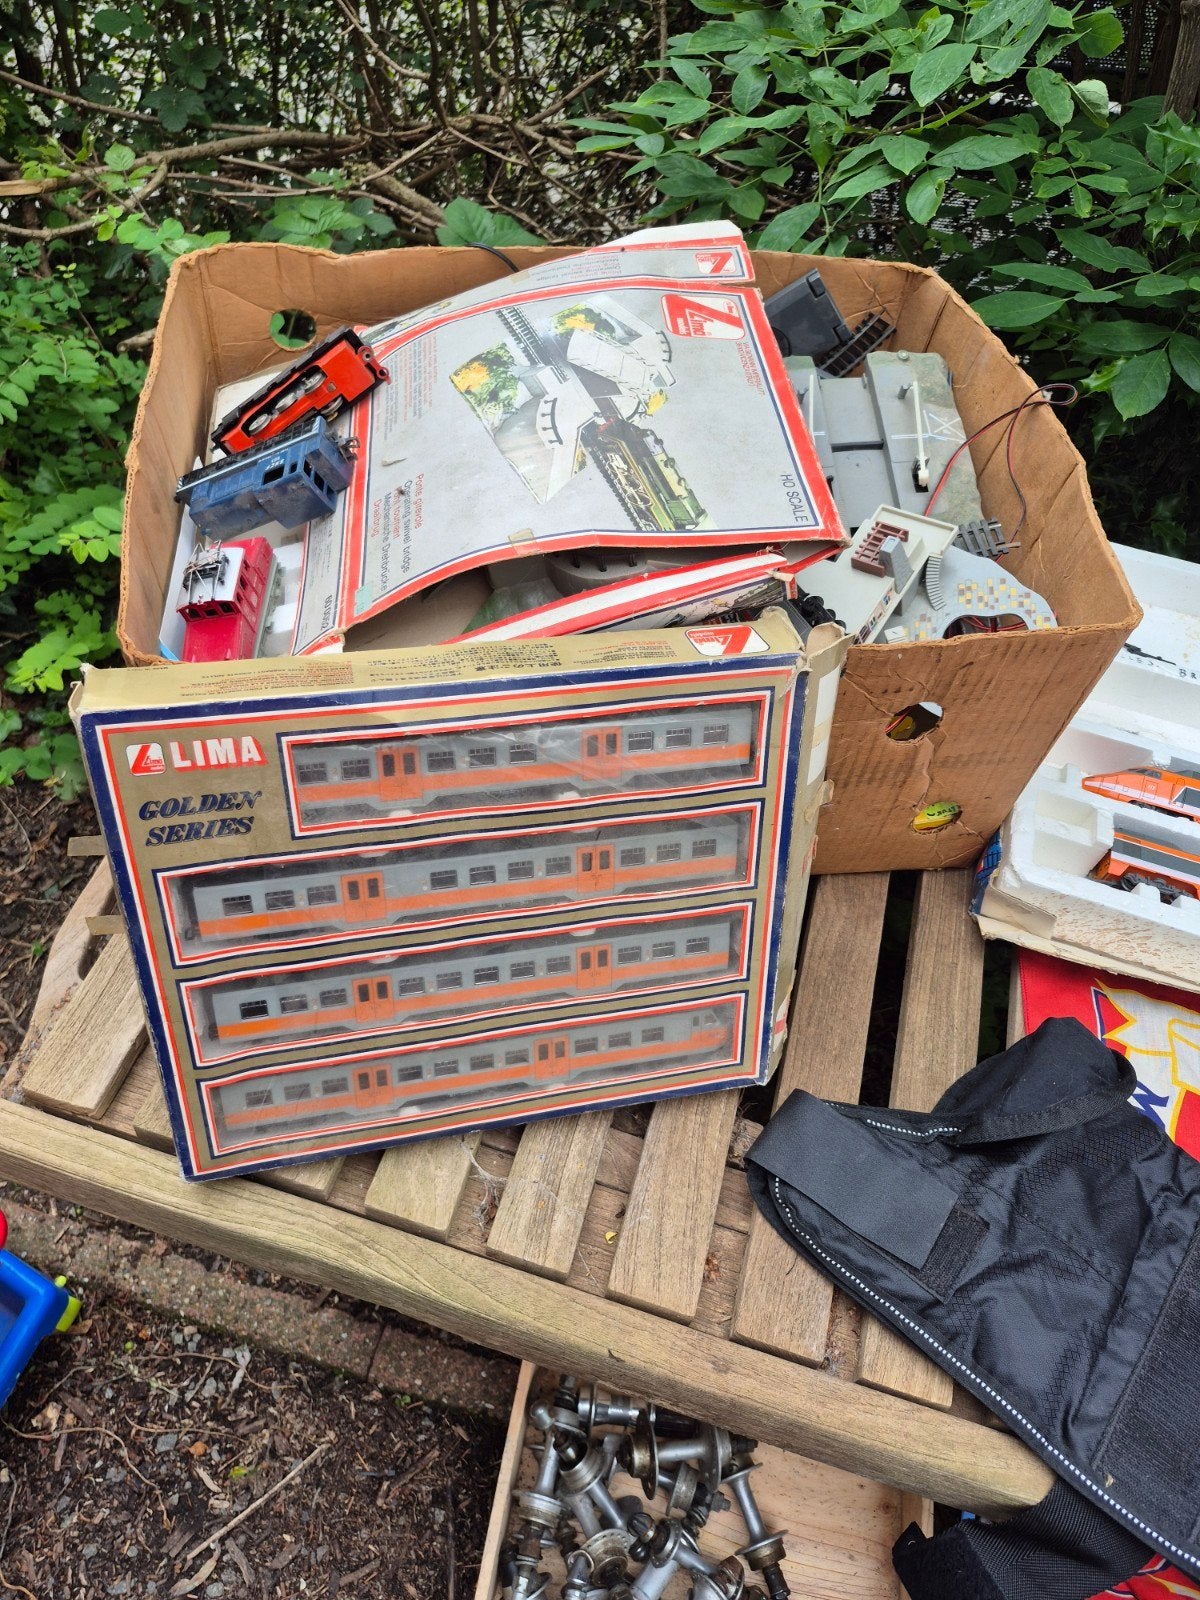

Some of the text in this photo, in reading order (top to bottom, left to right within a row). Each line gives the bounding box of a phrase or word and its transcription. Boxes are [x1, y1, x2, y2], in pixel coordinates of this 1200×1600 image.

[413, 473, 425, 530] Ponte girevole
[780, 474, 809, 523] HO SCALE
[380, 492, 392, 592] Mechanische Drehbrücke
[393, 505, 402, 540] tournant
[400, 480, 413, 574] Operating swivel bridge
[169, 736, 266, 771] LIMA
[138, 790, 263, 821] GOLDEN
[145, 816, 254, 847] SERIES
